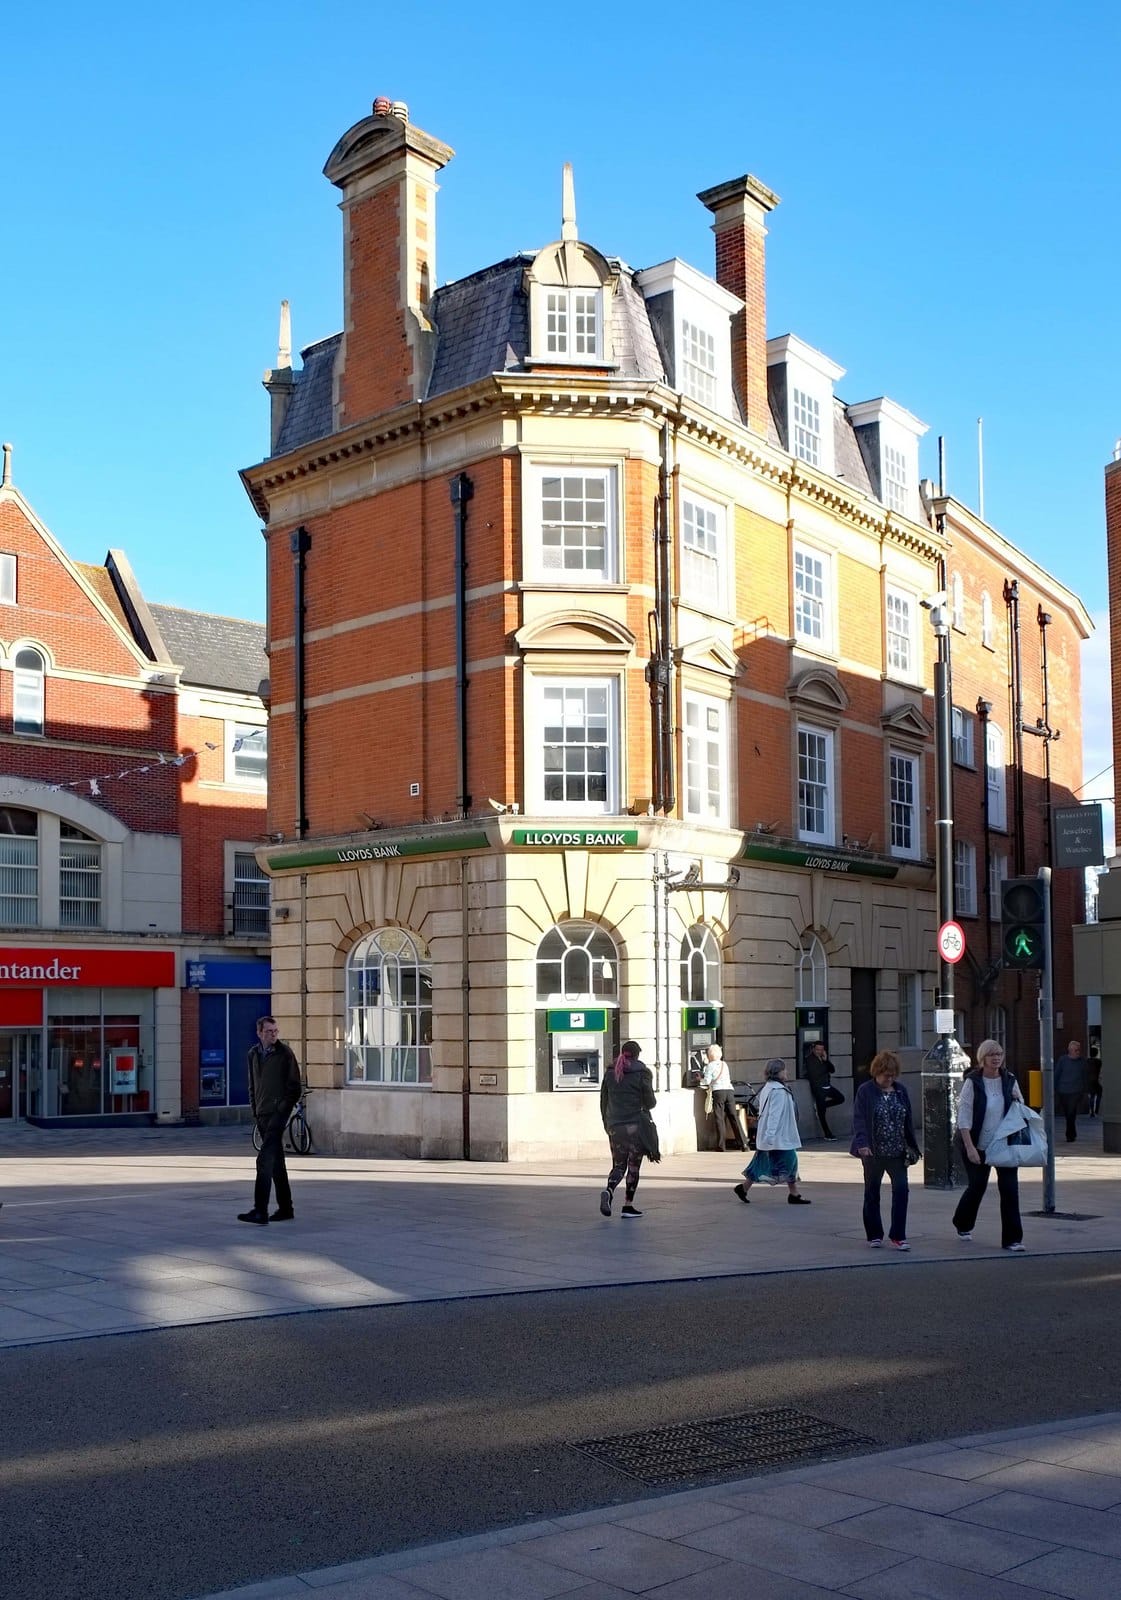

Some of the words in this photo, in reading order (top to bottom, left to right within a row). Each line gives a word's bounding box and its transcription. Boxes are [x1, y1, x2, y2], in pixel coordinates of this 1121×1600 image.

[1062, 826, 1092, 836] Jewellery
[526, 833, 581, 845] LLOYDS
[585, 833, 626, 845] BANK
[337, 849, 373, 862] LLOYDS
[373, 845, 401, 858] BANK
[805, 856, 831, 869] LLOYDS
[830, 860, 851, 872] BANK
